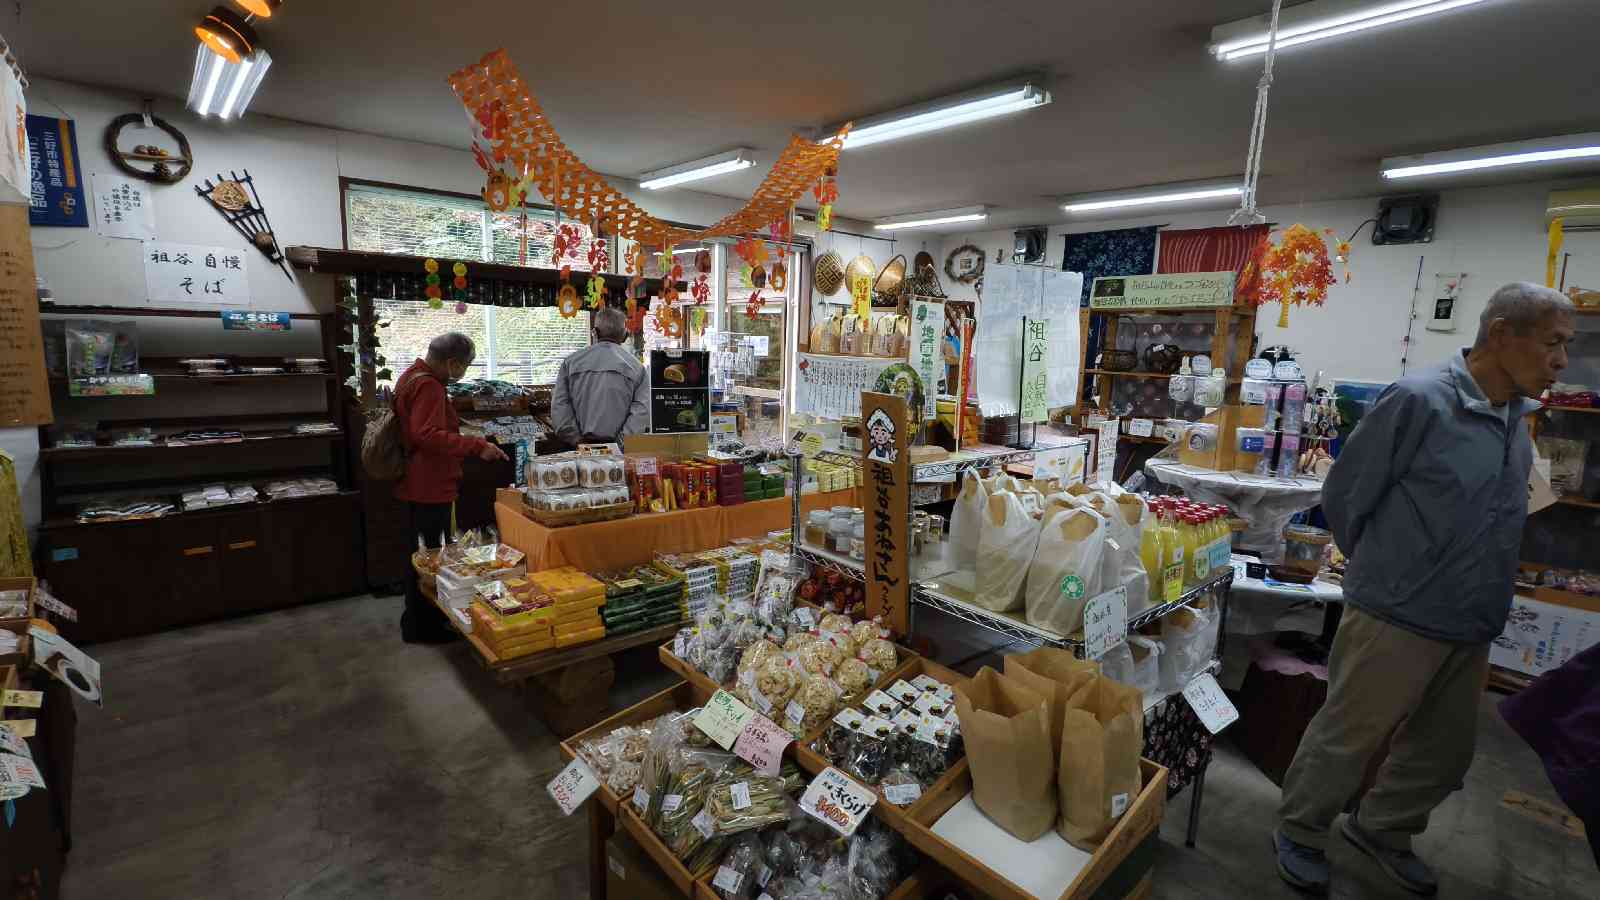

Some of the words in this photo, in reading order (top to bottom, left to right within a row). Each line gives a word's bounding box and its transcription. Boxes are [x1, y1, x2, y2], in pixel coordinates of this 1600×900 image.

[43, 130, 63, 187] 三好市特産品
[150, 249, 193, 266] 祖谷
[204, 252, 241, 270] 自慢
[179, 277, 226, 295] そば
[1028, 319, 1047, 363] 祖谷
[829, 784, 873, 816] きくらげ
